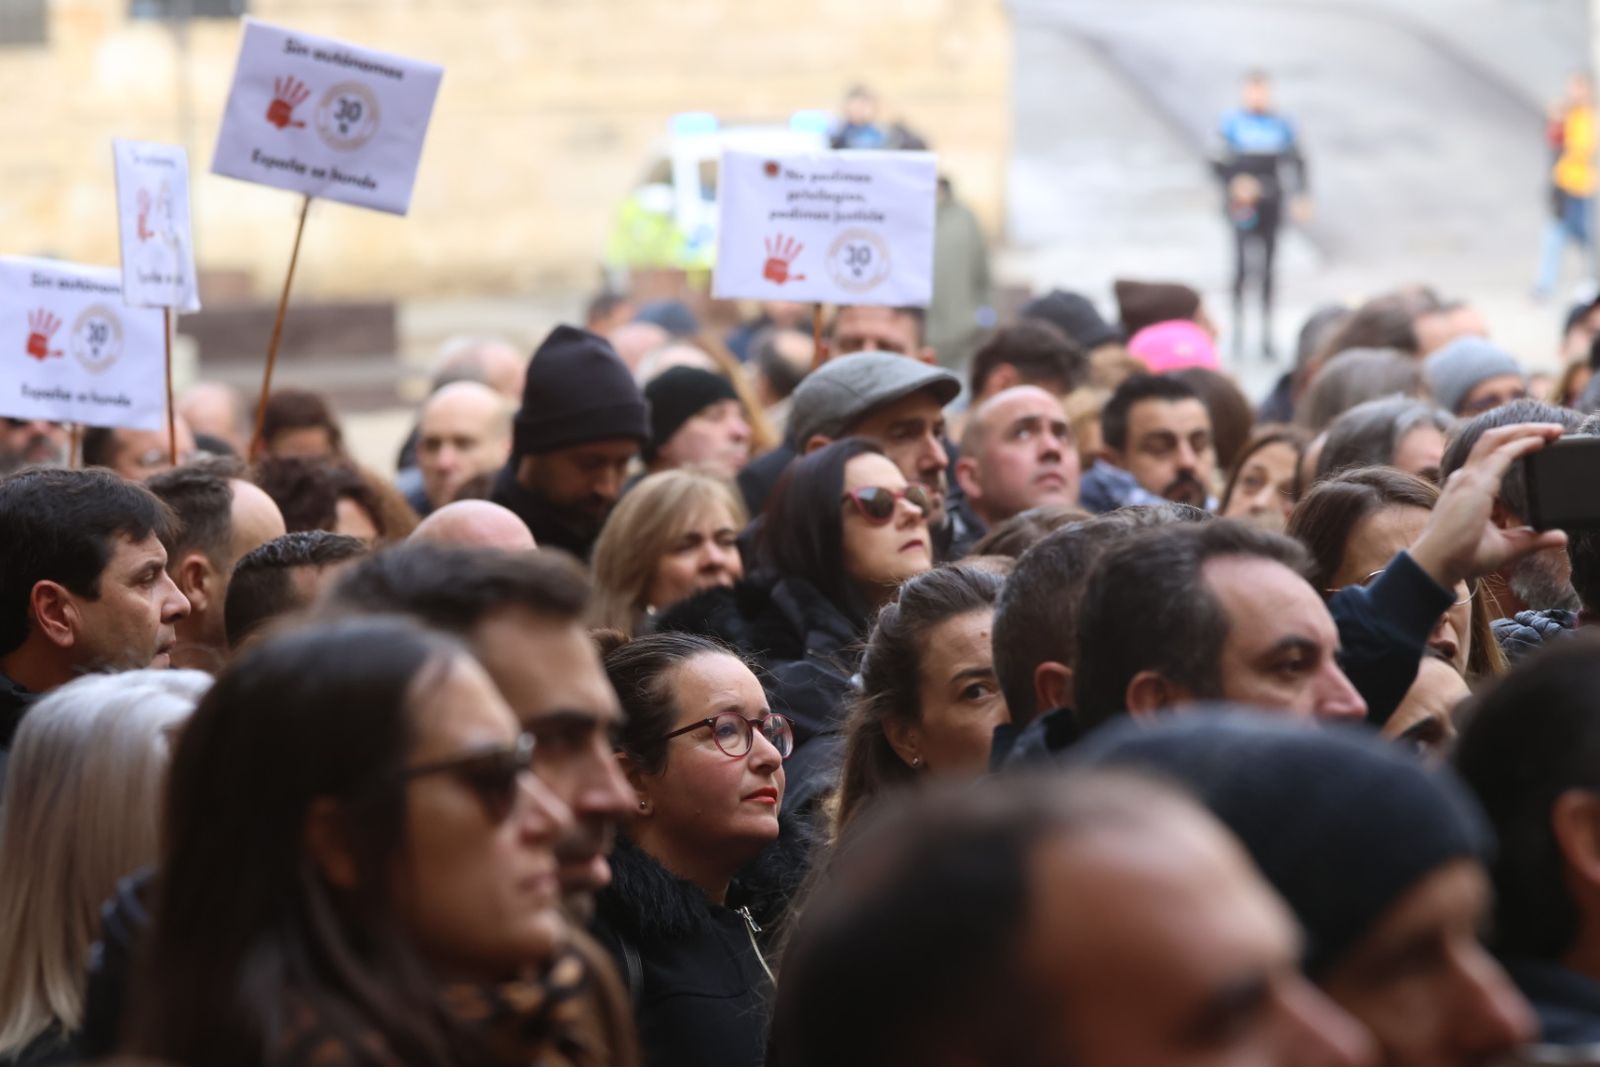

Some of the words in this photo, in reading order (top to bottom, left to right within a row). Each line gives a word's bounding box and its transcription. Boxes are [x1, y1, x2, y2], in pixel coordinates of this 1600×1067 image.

[284, 38, 308, 54] Sin
[334, 98, 362, 123] 30
[252, 149, 307, 175] España
[330, 167, 377, 190] hunda
[845, 245, 871, 267] 30
[31, 273, 51, 289] Sin
